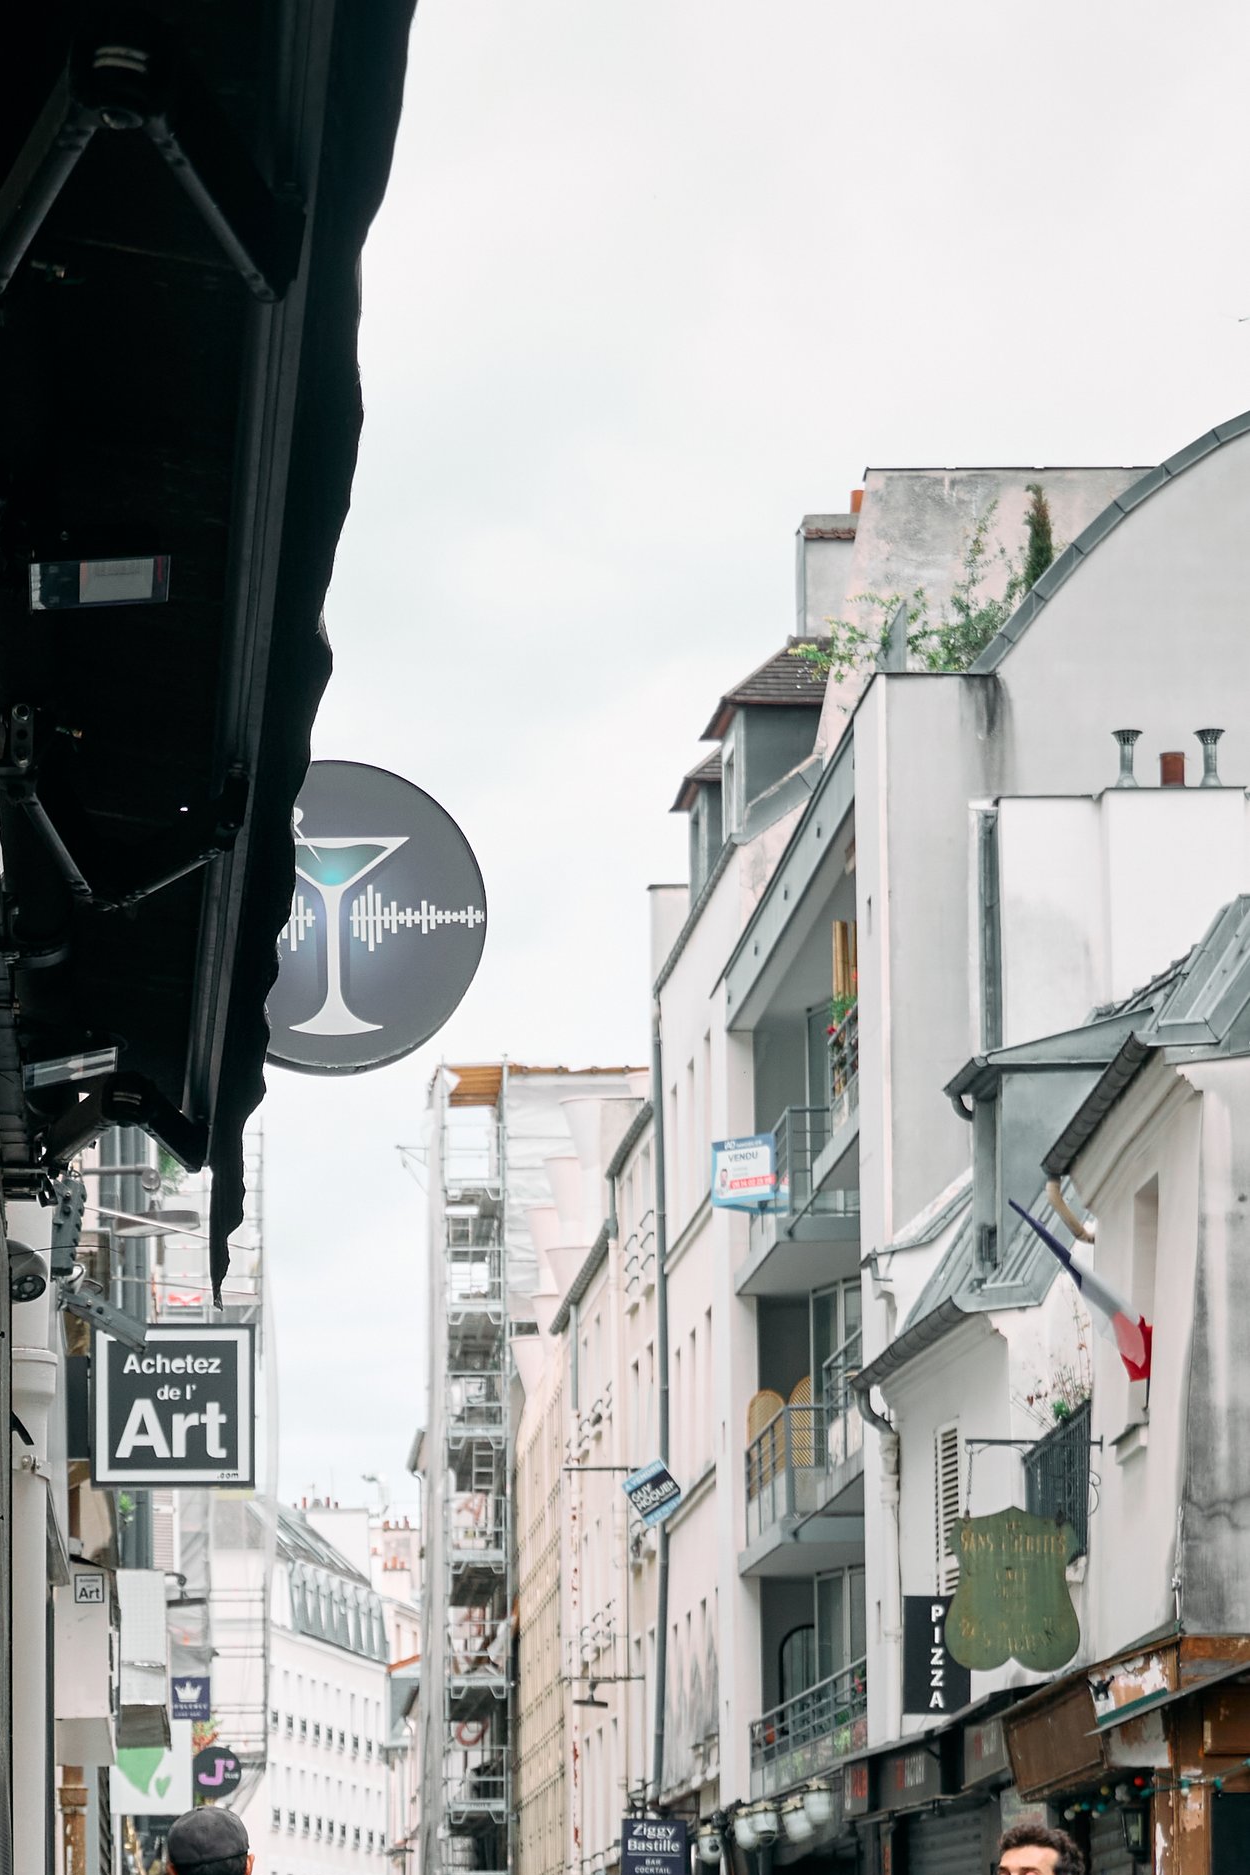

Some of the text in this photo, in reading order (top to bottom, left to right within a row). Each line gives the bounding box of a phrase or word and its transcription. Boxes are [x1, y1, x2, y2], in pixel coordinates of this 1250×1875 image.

[728, 1151, 758, 1162] VENDU
[123, 1354, 221, 1374] Achetez
[156, 1384, 181, 1400] de
[115, 1398, 227, 1458] Art
[631, 1483, 651, 1503] GUY
[79, 1587, 100, 1599] Art
[929, 1604, 945, 1708] PIZZA
[632, 1823, 676, 1839] Ziggy
[627, 1839, 680, 1852] Bastille
[634, 1865, 672, 1874] COCKTAIL
